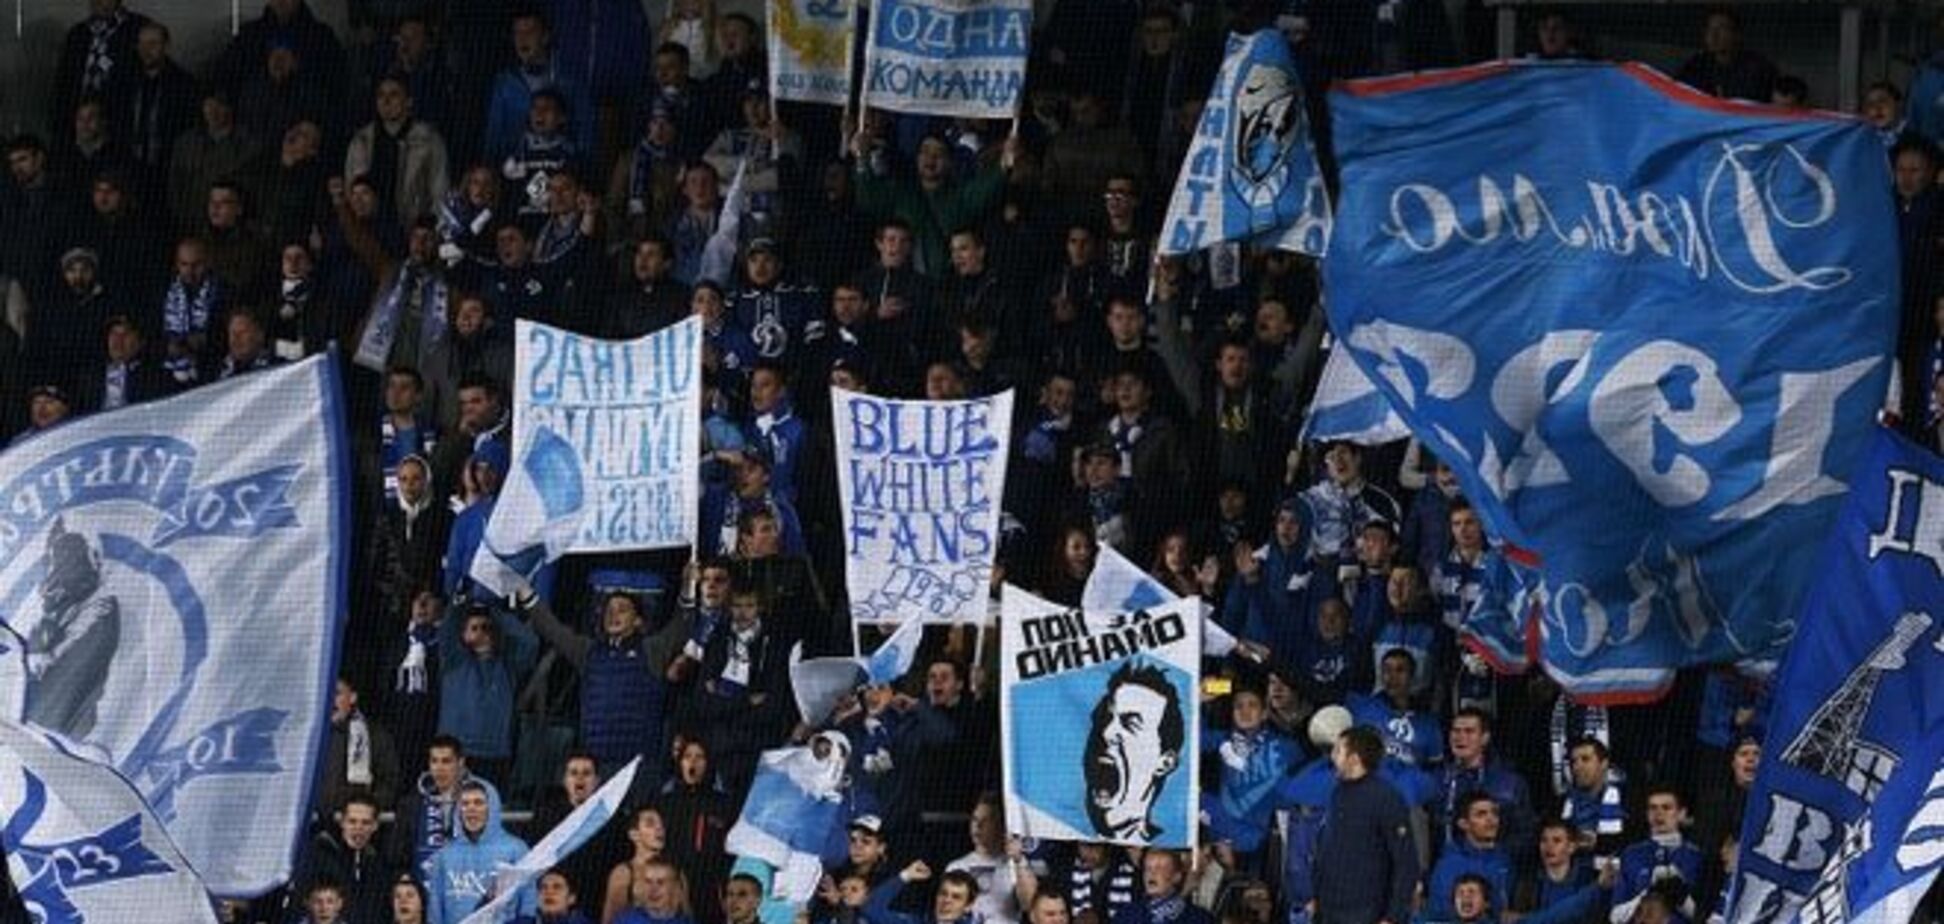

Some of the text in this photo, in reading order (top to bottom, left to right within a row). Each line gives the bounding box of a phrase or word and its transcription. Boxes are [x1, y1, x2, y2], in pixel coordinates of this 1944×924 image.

[891, 5, 1026, 52] ОДНА
[870, 57, 1022, 107] КОМАНДА
[849, 397, 999, 459] BLUE
[850, 454, 991, 513] WHITE
[850, 510, 992, 565] FANS
[1016, 612, 1186, 691] ДИНАМО
